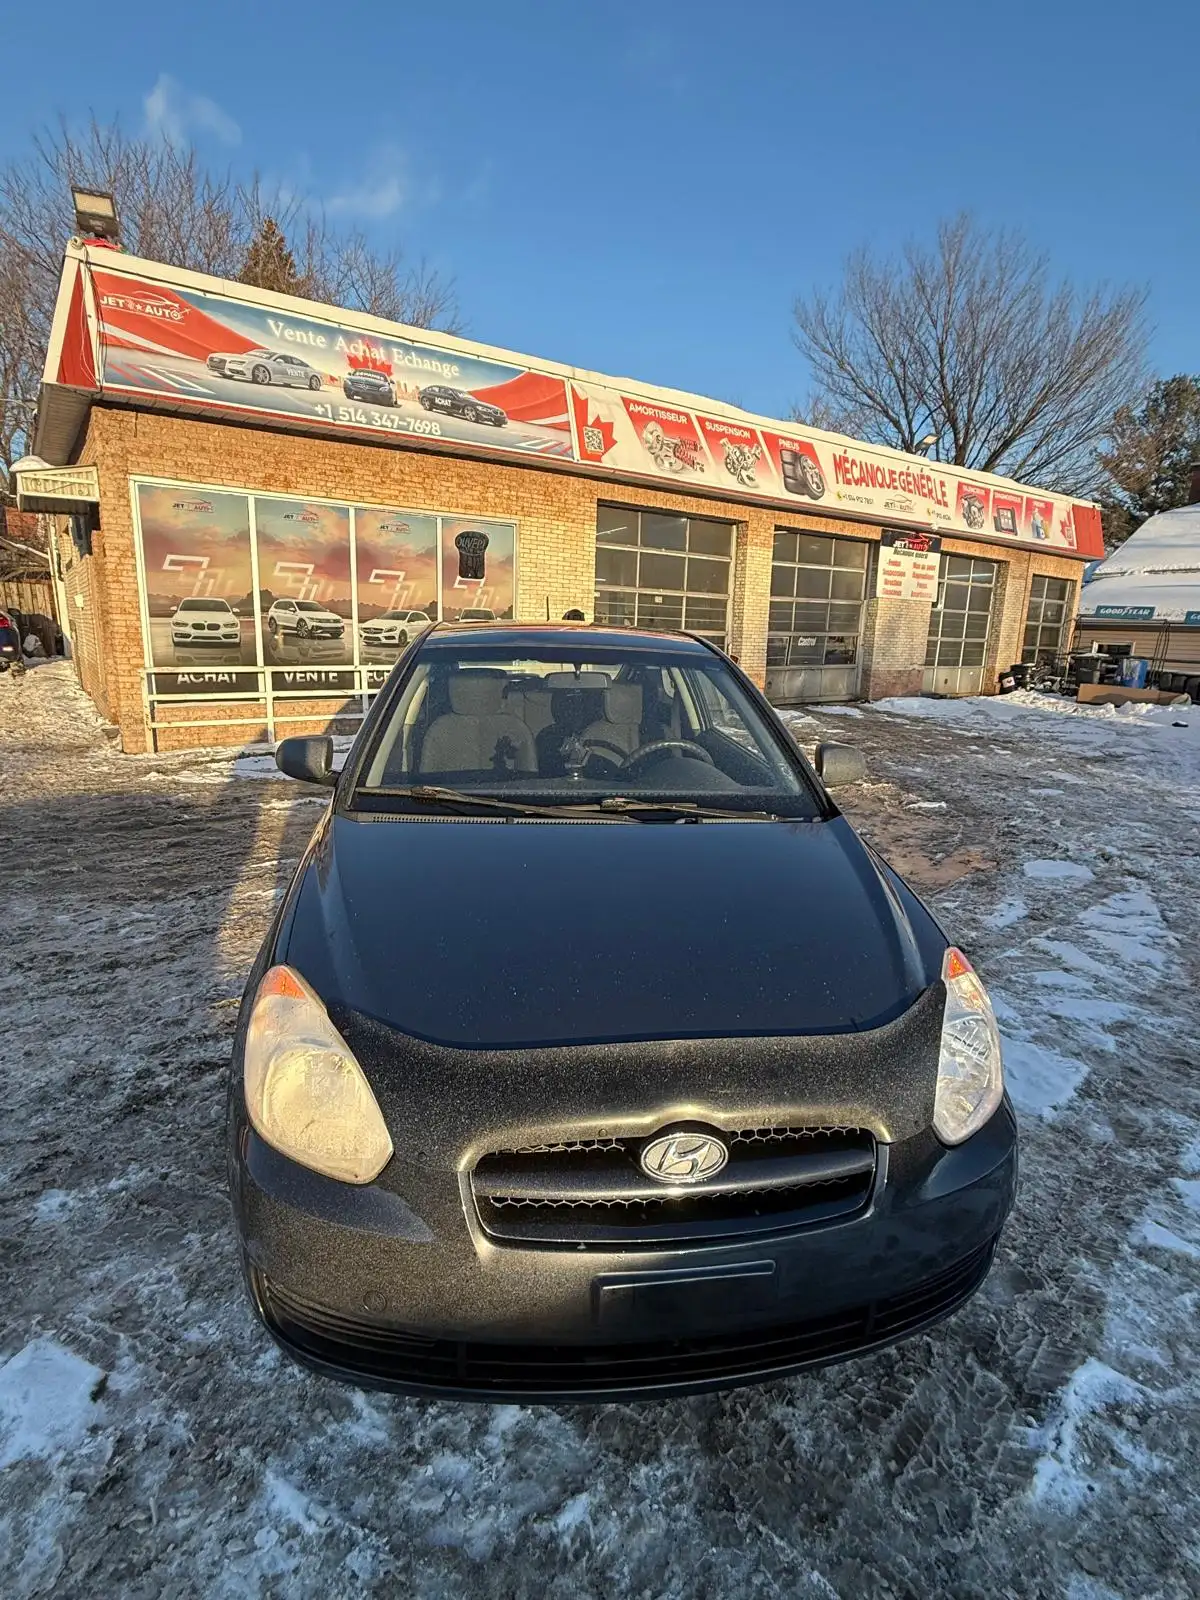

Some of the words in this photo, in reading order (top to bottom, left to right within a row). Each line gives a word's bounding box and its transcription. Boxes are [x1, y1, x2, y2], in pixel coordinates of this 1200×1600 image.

[100, 295, 125, 309] JET
[145, 304, 181, 320] AUTO
[266, 319, 327, 348] Vente
[336, 336, 386, 362] Achat
[393, 348, 460, 377] Echange
[314, 403, 333, 419] +1
[339, 407, 367, 423] 514
[371, 411, 442, 436] 347-7698
[628, 403, 688, 425] AMORTISSEUR
[705, 421, 751, 439] SUSPENSION
[778, 438, 800, 451] PNEUS
[1100, 606, 1151, 616] GOODYEAR
[176, 671, 237, 685] ACHAT
[283, 671, 339, 684] VENTE
